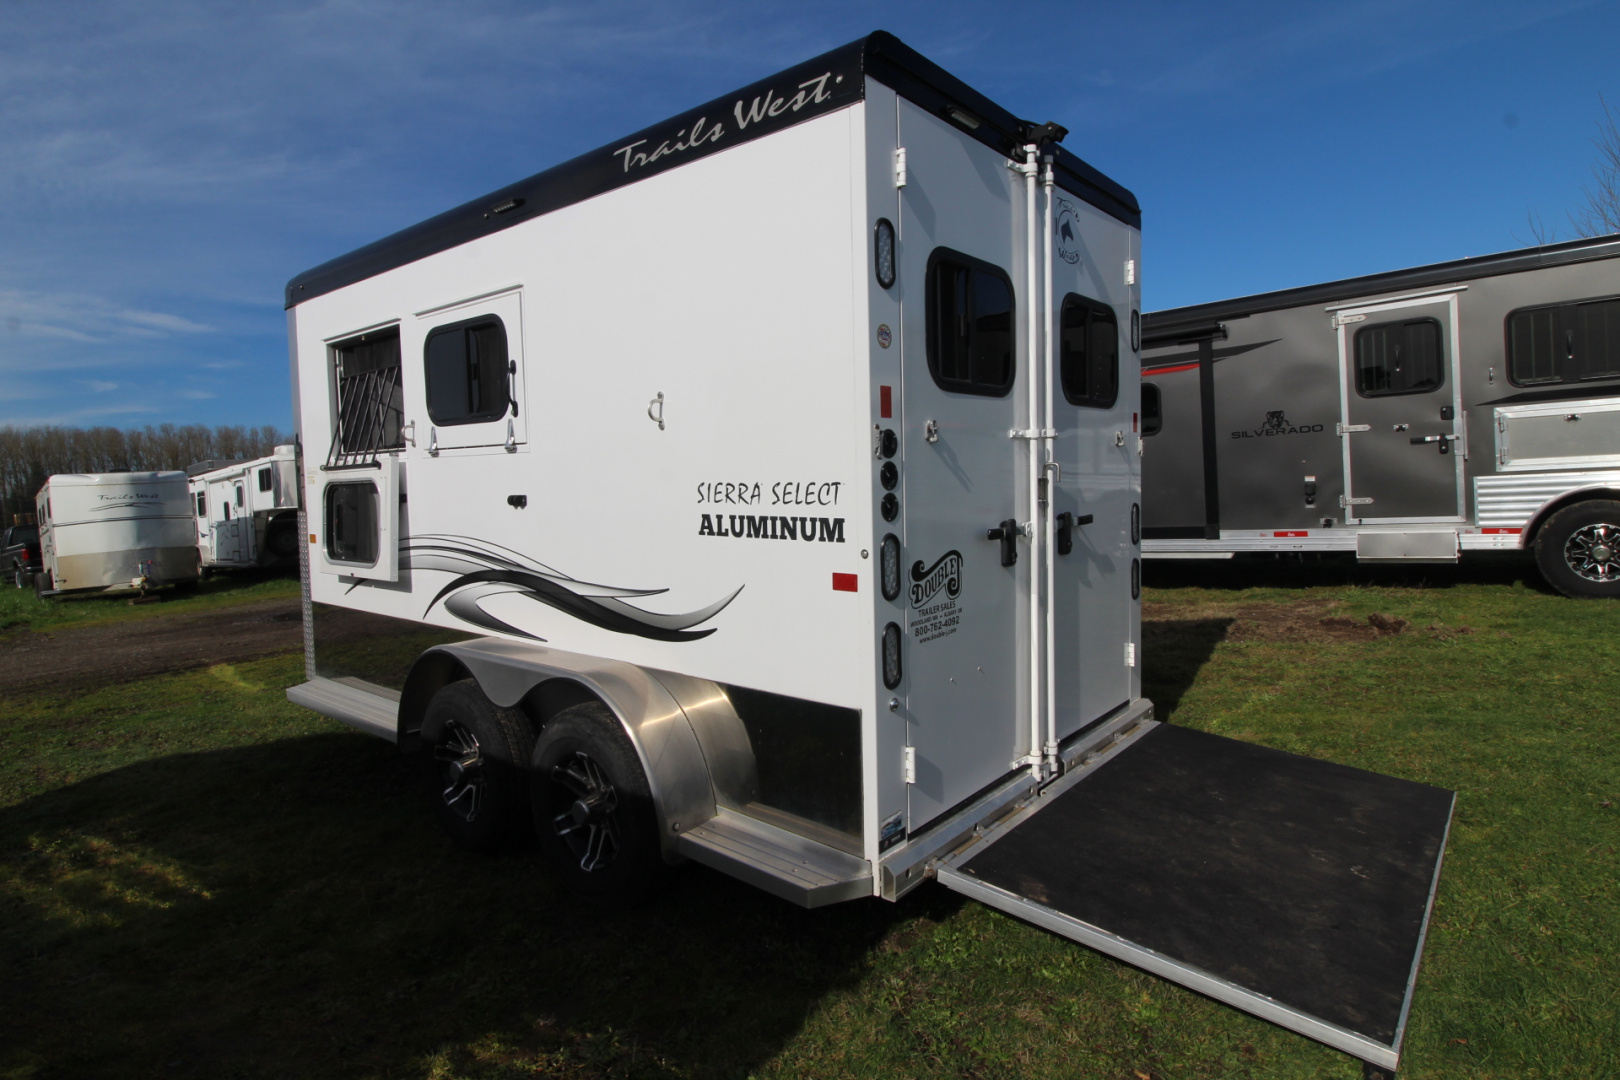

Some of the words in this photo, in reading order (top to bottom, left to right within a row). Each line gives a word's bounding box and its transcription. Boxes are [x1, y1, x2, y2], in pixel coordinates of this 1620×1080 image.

[613, 117, 725, 173] Trails
[734, 72, 832, 130] West
[1231, 424, 1324, 440] SILVERADO
[697, 482, 761, 506] SIERRA
[771, 482, 841, 506] SELECT
[698, 514, 846, 543] ALUMINUM
[912, 557, 957, 605] DOUBLE
[918, 604, 940, 617] TRAILER
[941, 600, 956, 612] SALES
[915, 615, 960, 637] 800-762-4092
